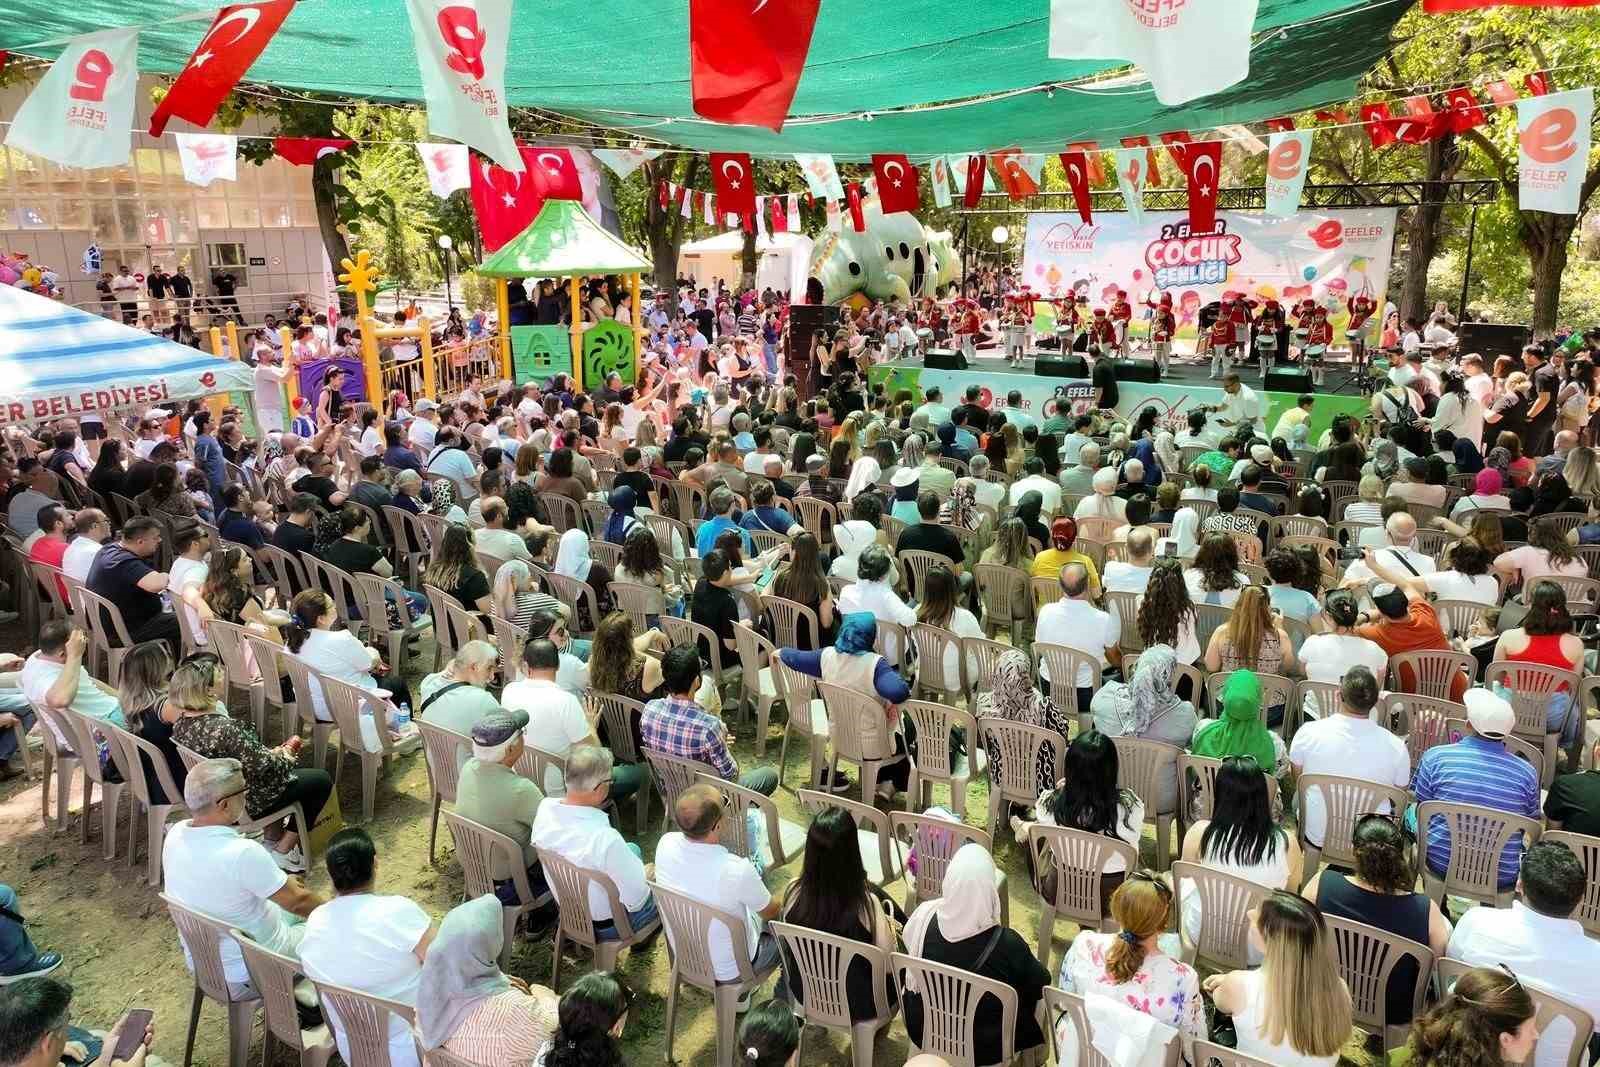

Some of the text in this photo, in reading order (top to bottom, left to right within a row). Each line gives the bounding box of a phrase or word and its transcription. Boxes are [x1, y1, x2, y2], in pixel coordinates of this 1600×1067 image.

[1162, 226, 1176, 240] 2.
[1345, 226, 1383, 237] EFELER
[199, 372, 217, 388] e
[32, 379, 169, 419] BELEDİYESİ
[1067, 386, 1096, 398] EFELE
